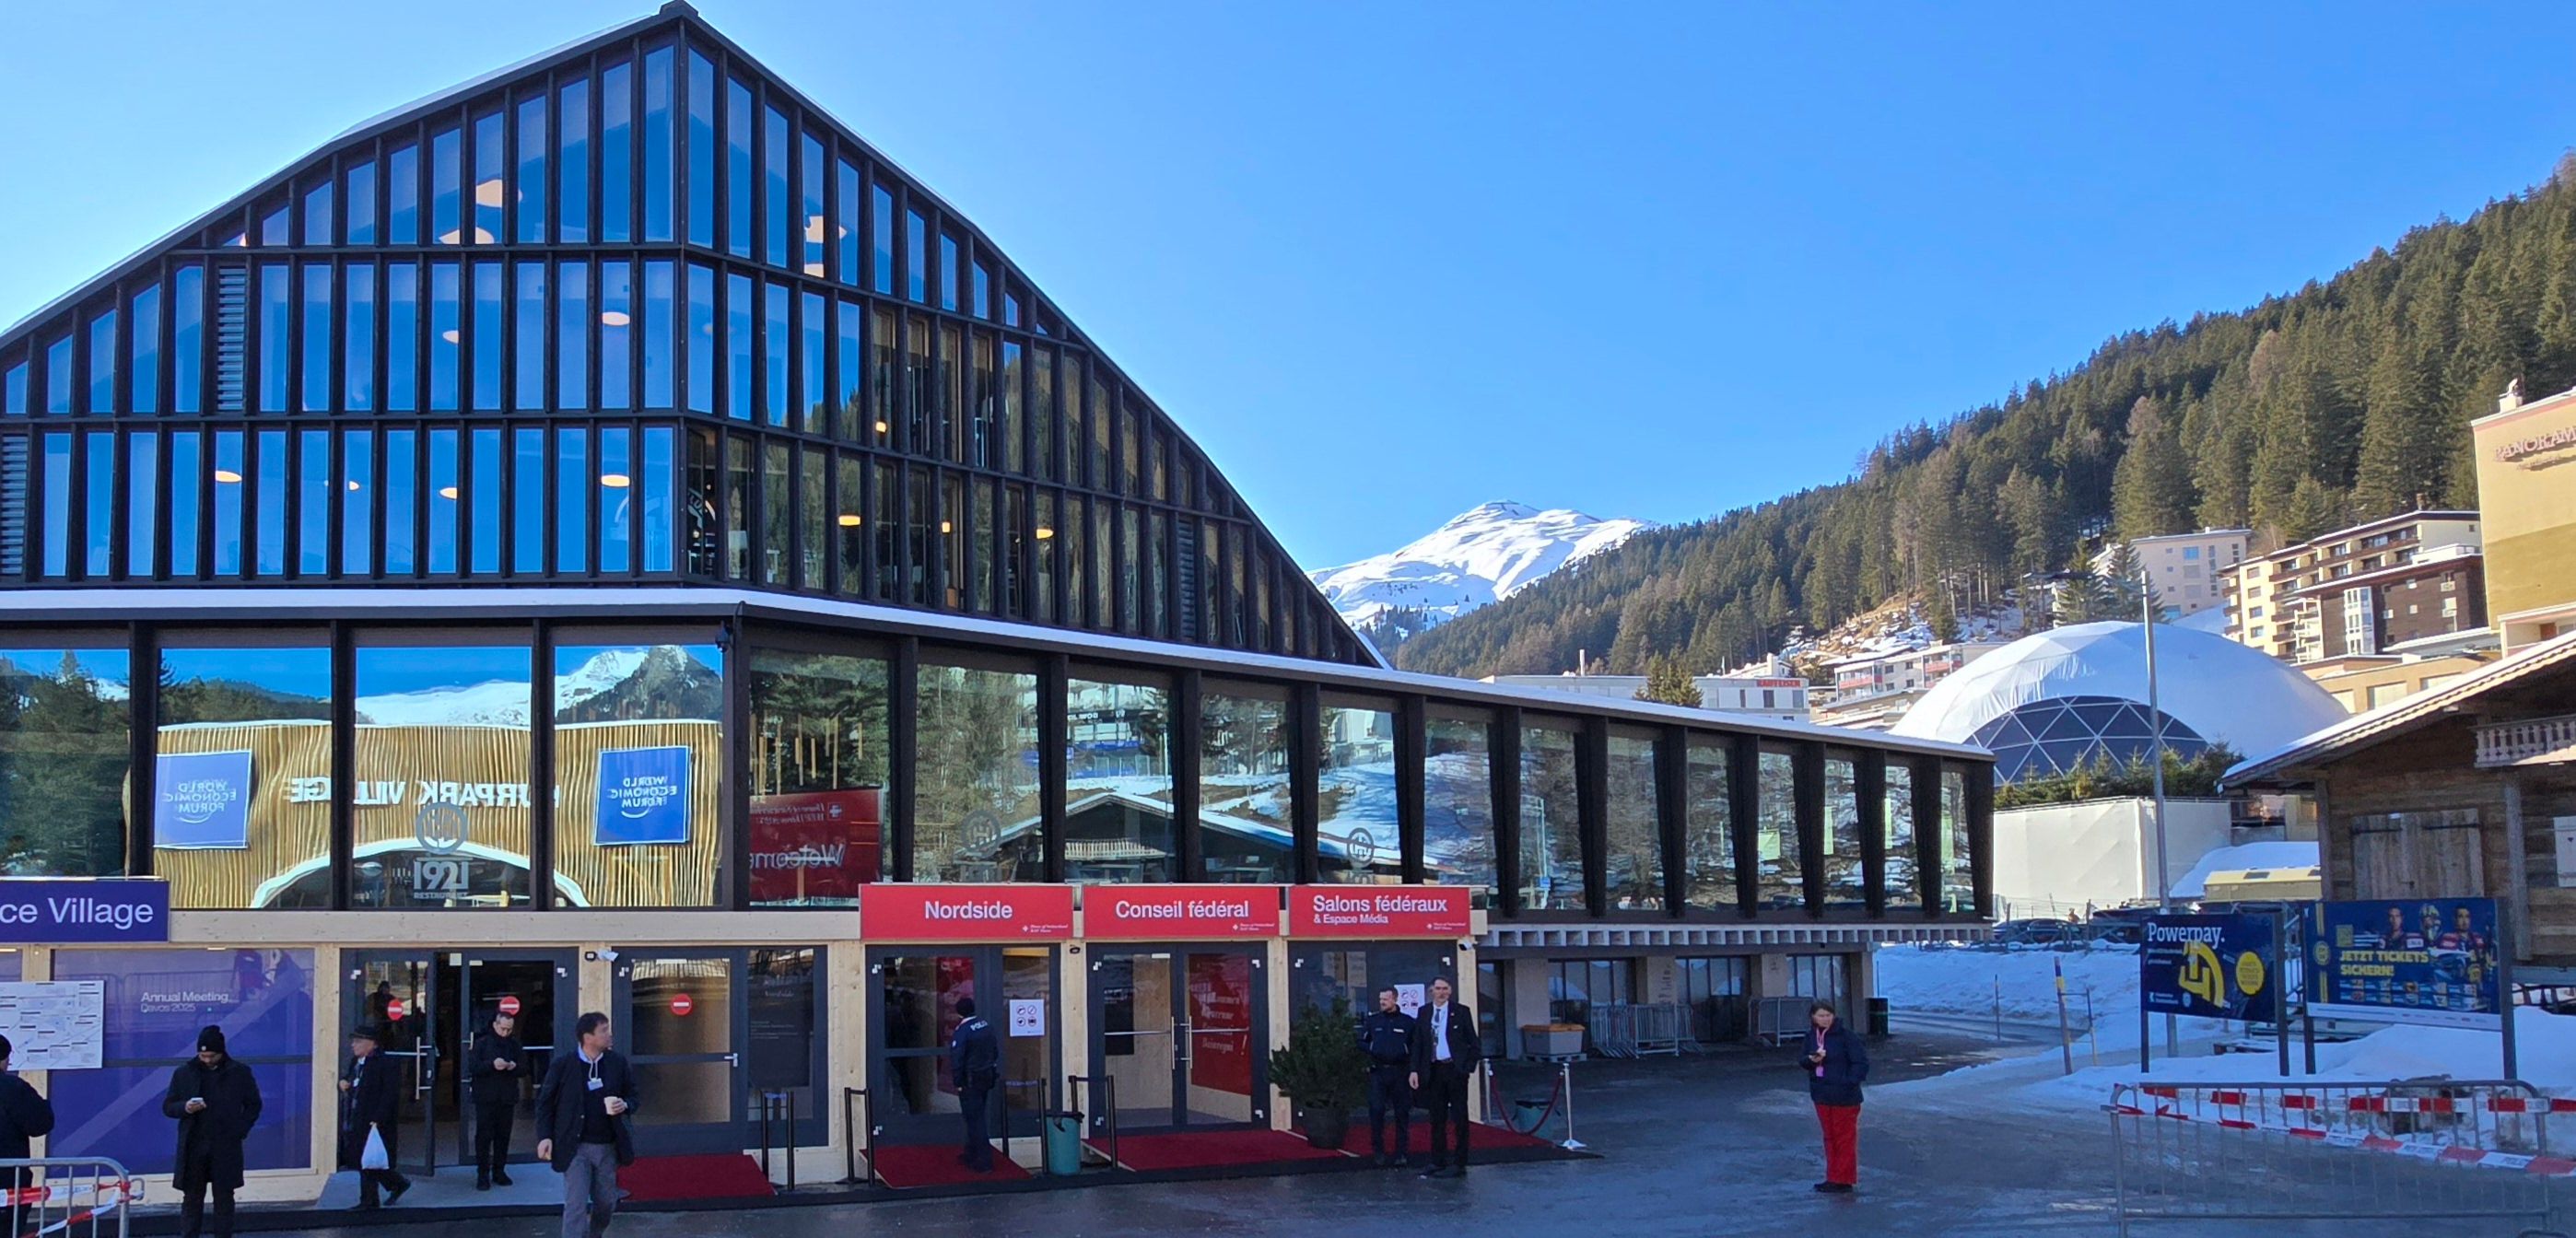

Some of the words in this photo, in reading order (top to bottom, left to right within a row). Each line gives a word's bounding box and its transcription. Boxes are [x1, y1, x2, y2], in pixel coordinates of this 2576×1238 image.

[413, 860, 469, 890] 1921
[925, 901, 1013, 919] Nordside
[1116, 900, 1183, 918] Conseil
[1188, 899, 1249, 918] fédéral
[1313, 894, 1371, 913] Salons
[1375, 894, 1447, 913] fédéraux
[47, 897, 154, 929] Village
[1313, 914, 1321, 924] &
[1323, 914, 1357, 925] Espace
[1359, 914, 1388, 924] Média
[2147, 922, 2226, 950] Powerpay.
[2339, 951, 2374, 962] JETZT
[2376, 951, 2430, 963] TICKETS
[140, 992, 181, 1002] Annual
[182, 992, 229, 1004] Meeting
[140, 1003, 170, 1012] Davos
[170, 1003, 196, 1012] 2025
